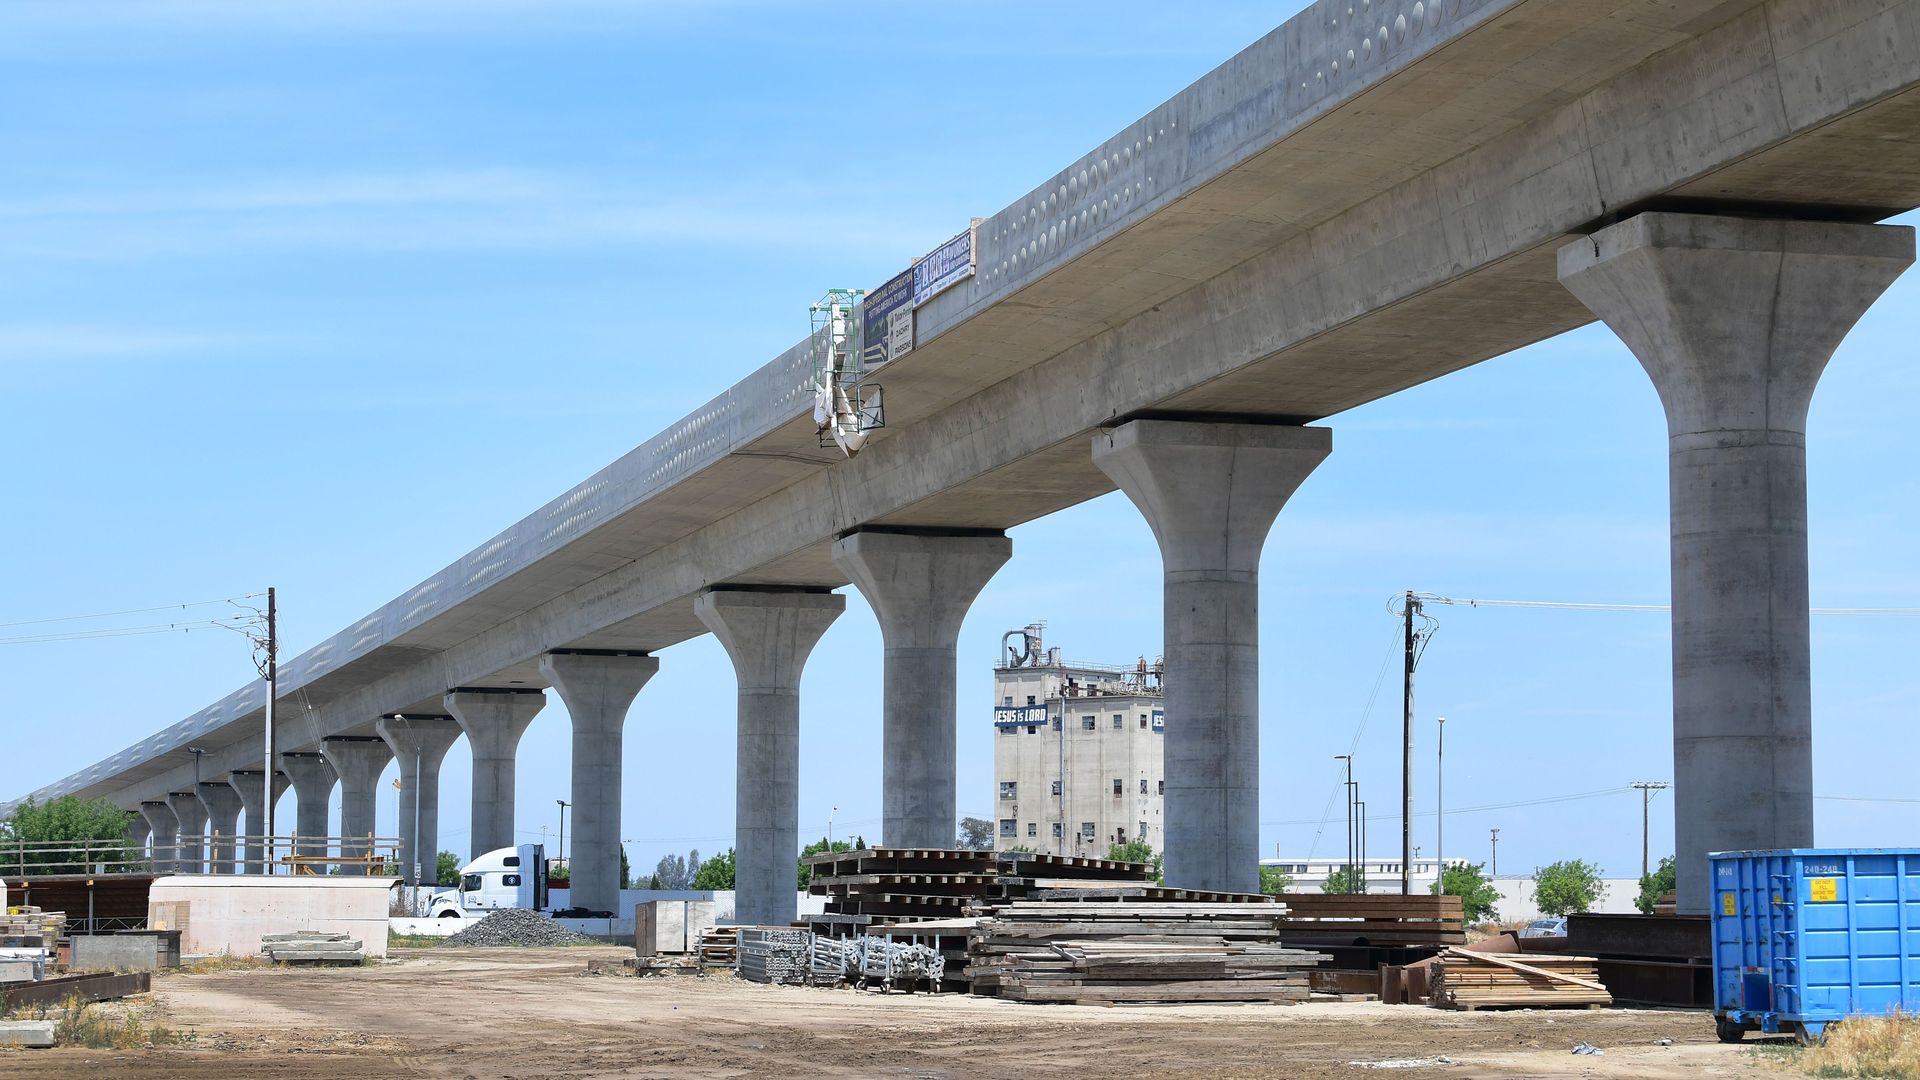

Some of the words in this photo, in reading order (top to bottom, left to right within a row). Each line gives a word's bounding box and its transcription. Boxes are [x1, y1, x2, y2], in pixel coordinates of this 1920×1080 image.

[994, 710, 1017, 723] JESUS
[1017, 710, 1024, 721] is
[1024, 708, 1047, 722] LORD
